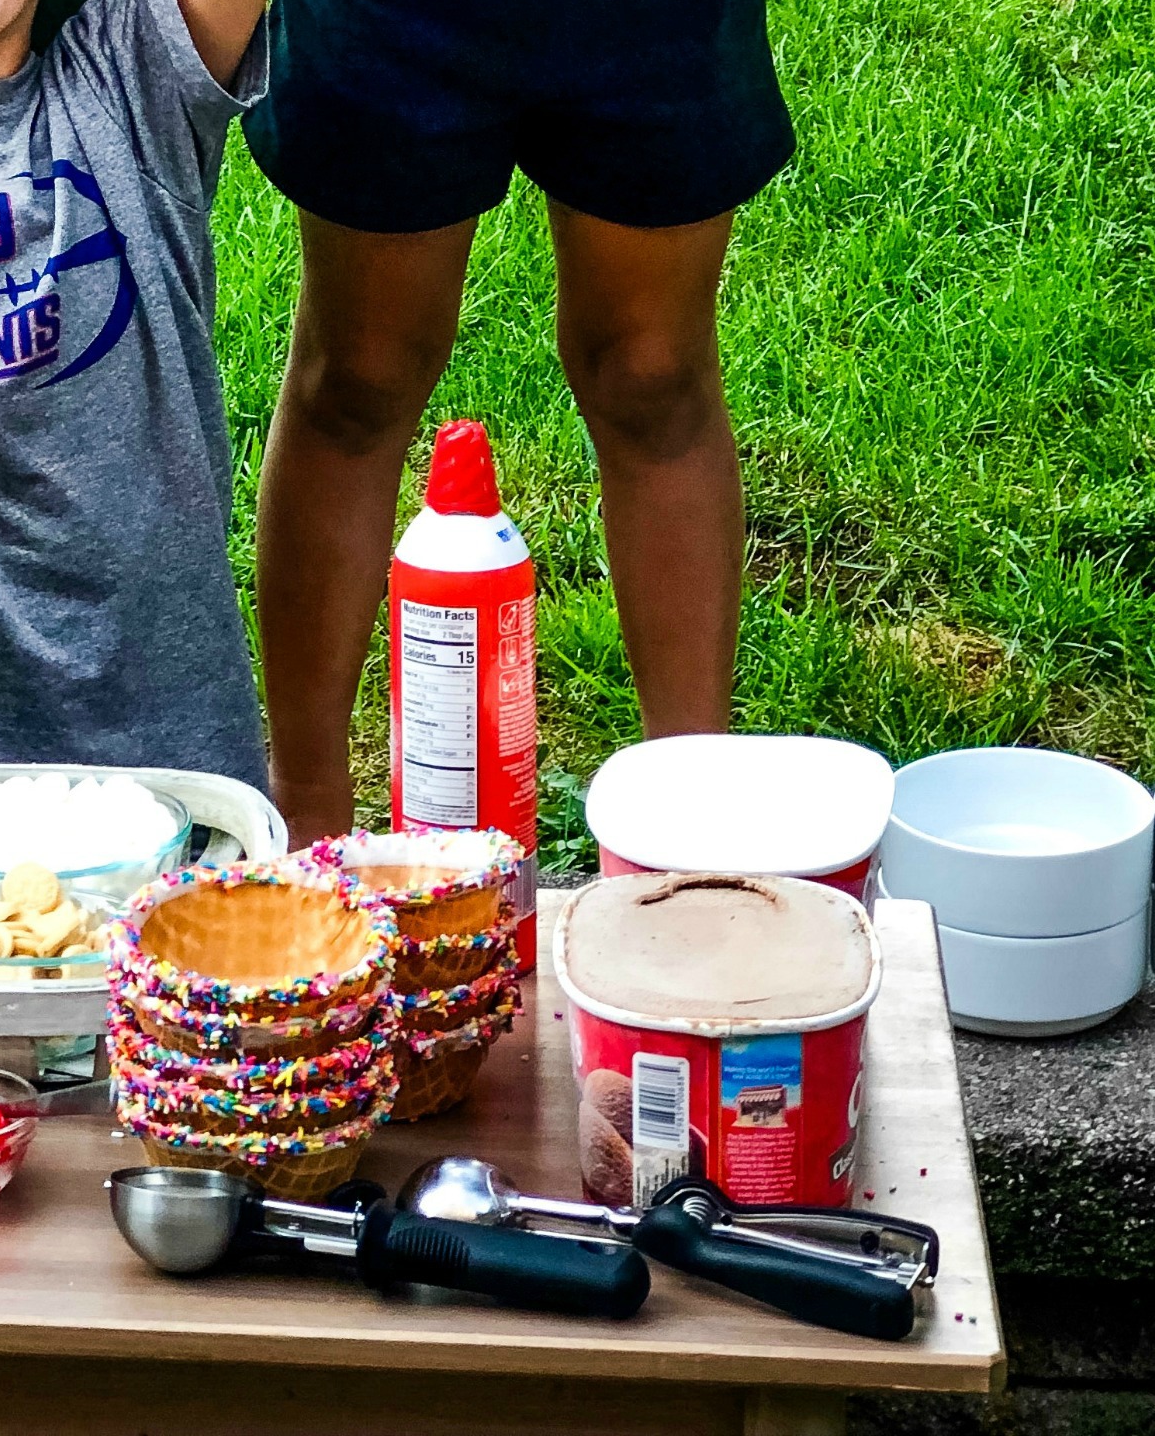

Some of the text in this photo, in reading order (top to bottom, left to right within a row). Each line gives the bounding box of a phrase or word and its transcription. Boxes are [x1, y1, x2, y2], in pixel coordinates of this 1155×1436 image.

[403, 601, 442, 619] Nutrition
[444, 609, 475, 621] Facts
[403, 645, 437, 663] Calories
[458, 650, 475, 664] 15
